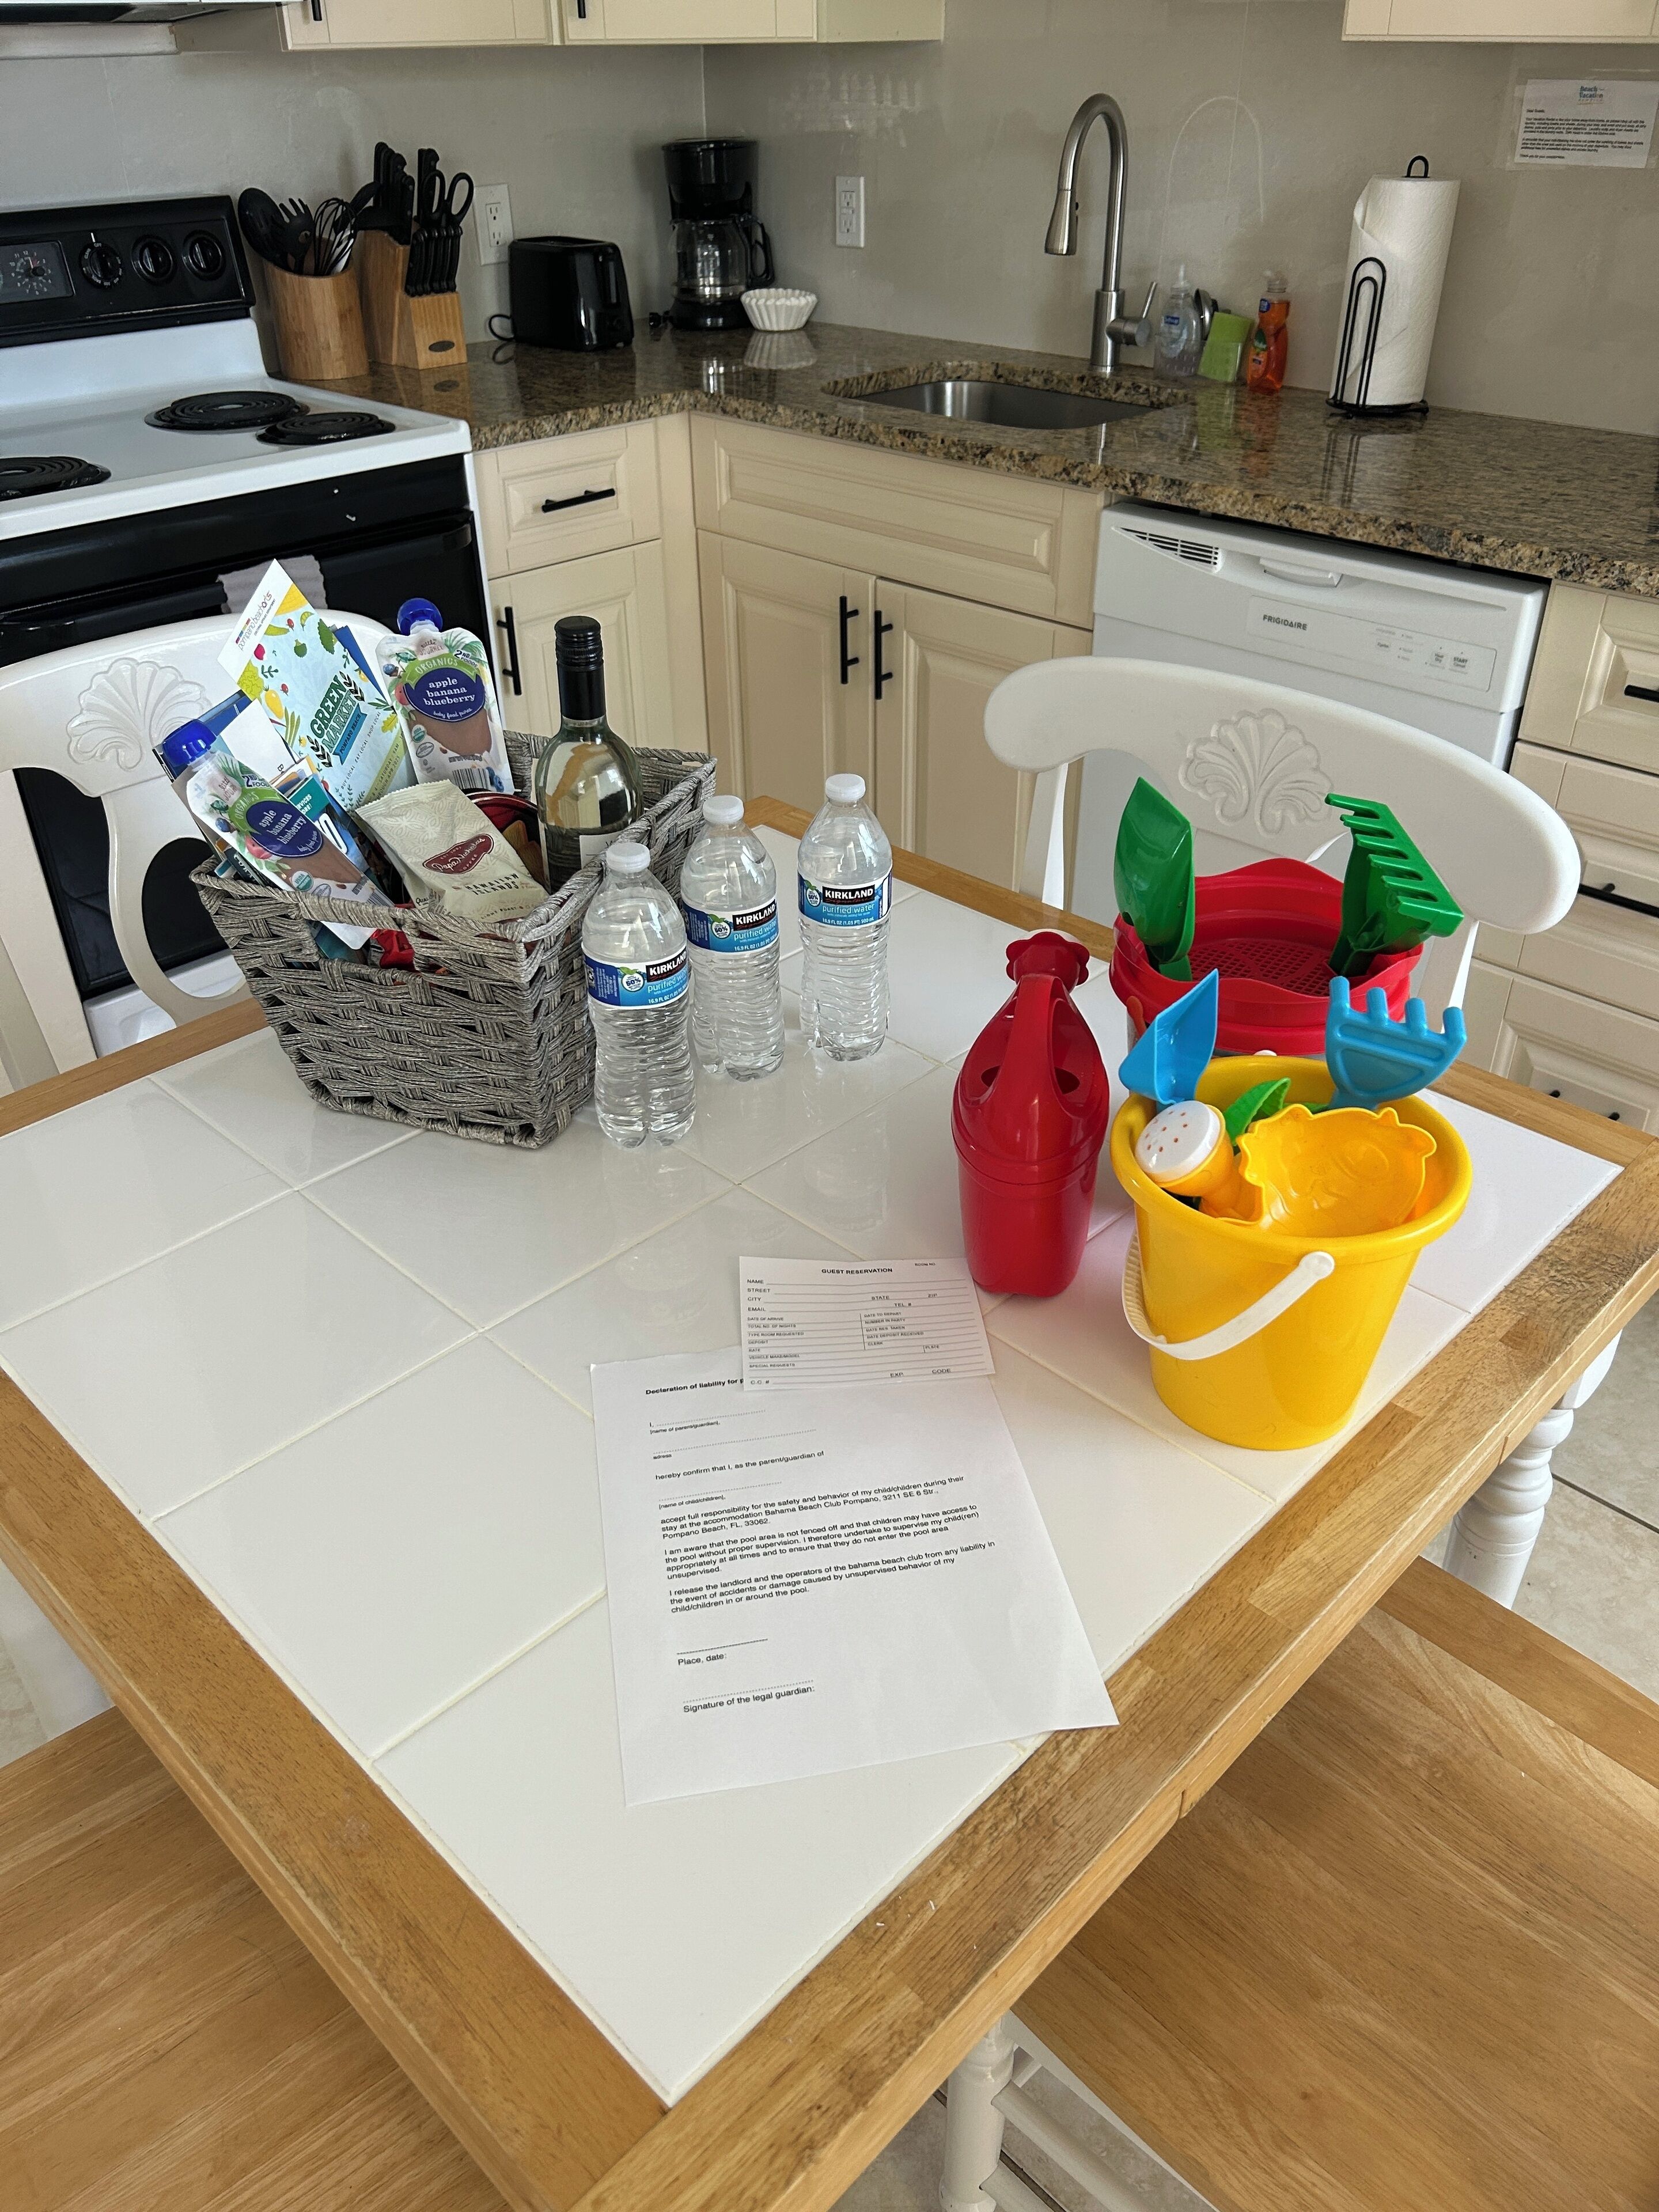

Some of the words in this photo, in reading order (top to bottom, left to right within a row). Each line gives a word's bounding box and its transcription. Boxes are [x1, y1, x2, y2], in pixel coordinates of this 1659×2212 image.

[1263, 614, 1307, 631] FRIGIDAIRE
[415, 658, 459, 675] ORGANICS
[461, 657, 478, 668] FOODS
[429, 677, 458, 688] apple
[423, 694, 475, 706] blueberry
[426, 686, 467, 698] banana
[310, 675, 346, 738] GREEN
[446, 710, 459, 719] food
[321, 690, 357, 753] MARKET
[340, 729, 353, 754] POMPANO
[352, 714, 361, 733] BEACH
[346, 766, 355, 779] LOCAL
[359, 740, 369, 754] LOCAL
[378, 757, 393, 783] SATURDAY
[235, 791, 259, 819] ORGANICS
[259, 810, 277, 828] apple
[267, 813, 293, 835] banana
[277, 816, 307, 844] blueberry
[295, 873, 305, 885] USDA
[465, 873, 520, 891] HAWAIIAN
[472, 881, 520, 895] ISLANDS
[825, 888, 874, 899] KIRKLAND
[736, 904, 775, 925] KIRKLAND
[823, 905, 851, 914] purified
[853, 904, 874, 913] water
[734, 928, 763, 941] purified
[649, 950, 687, 976] KIRKLAND
[648, 978, 676, 993] purified
[645, 1385, 688, 1395] Declaration
[699, 1380, 726, 1388] liability
[655, 1472, 681, 1480] hereby
[683, 1468, 710, 1476] confirm
[759, 1453, 816, 1467] parent/guardian
[660, 1514, 687, 1524] accept
[687, 1512, 699, 1520] full
[699, 1505, 752, 1518] responsibility
[777, 1498, 801, 1507] safety
[802, 1495, 816, 1503] and
[817, 1491, 850, 1501] behavior
[851, 1490, 859, 1498] of
[873, 1483, 923, 1495] child/children
[922, 1479, 947, 1488] during
[947, 1475, 964, 1483] their
[662, 1529, 700, 1540] Pompano
[701, 1524, 729, 1535] Beach,
[682, 1544, 708, 1553] aware
[709, 1540, 725, 1549] that
[740, 1535, 757, 1545] pool
[800, 1525, 827, 1535] fenced
[840, 1521, 855, 1530] and
[872, 1516, 903, 1525] children
[941, 1506, 968, 1516] access
[667, 1565, 722, 1580] unsupervised.
[671, 1600, 724, 1613] child/children
[743, 1590, 774, 1601] around
[790, 1586, 810, 1596] pool.
[677, 1657, 704, 1666] Place,
[705, 1653, 727, 1662] date:
[683, 1700, 725, 1713] Signature
[726, 1697, 735, 1706] of
[736, 1696, 751, 1705] the
[752, 1691, 774, 1702] legal
[775, 1686, 815, 1700] guardian:
